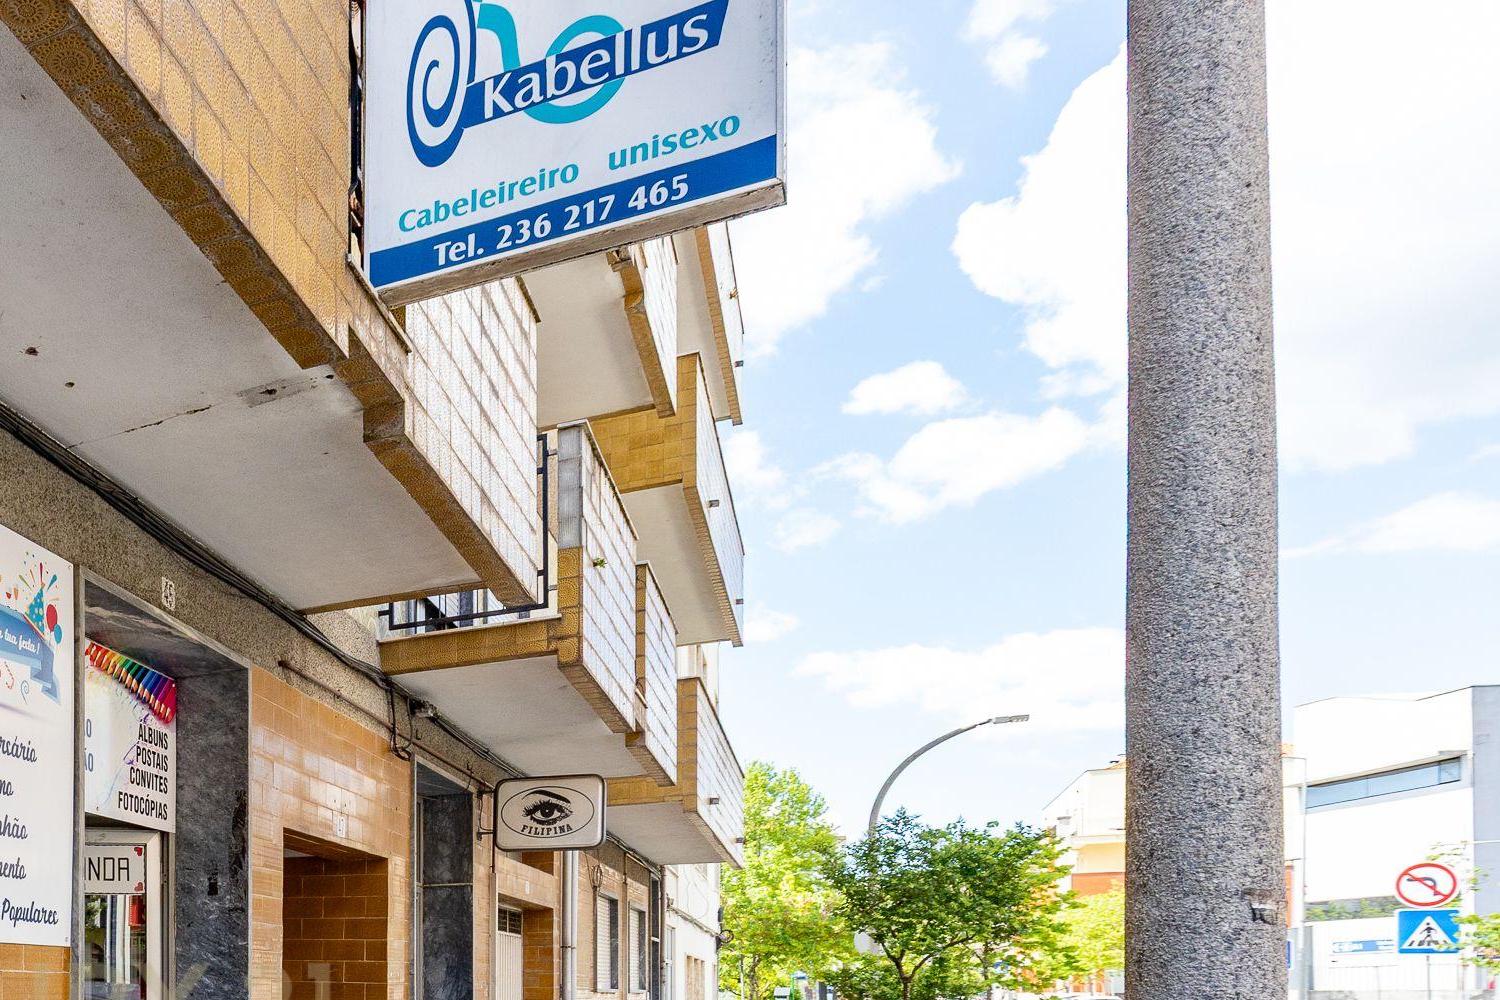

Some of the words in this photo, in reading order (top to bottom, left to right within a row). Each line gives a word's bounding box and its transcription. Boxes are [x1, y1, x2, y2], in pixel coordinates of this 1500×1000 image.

[484, 12, 708, 119] Kabellus
[399, 162, 580, 233] Cabeleireiro
[608, 114, 741, 171] unisexo
[434, 234, 484, 267] Tel.
[497, 213, 552, 250] 236
[564, 194, 616, 232] 217
[628, 174, 690, 212] 465
[4, 629, 18, 646] tua
[138, 719, 169, 751] ÁLBUNS
[135, 745, 169, 773] POSTAIS
[129, 766, 168, 795] CONVITES
[118, 791, 168, 821] FOTOCÓPIAS
[521, 823, 573, 837] FILIPINA
[1, 897, 59, 928] Populares
